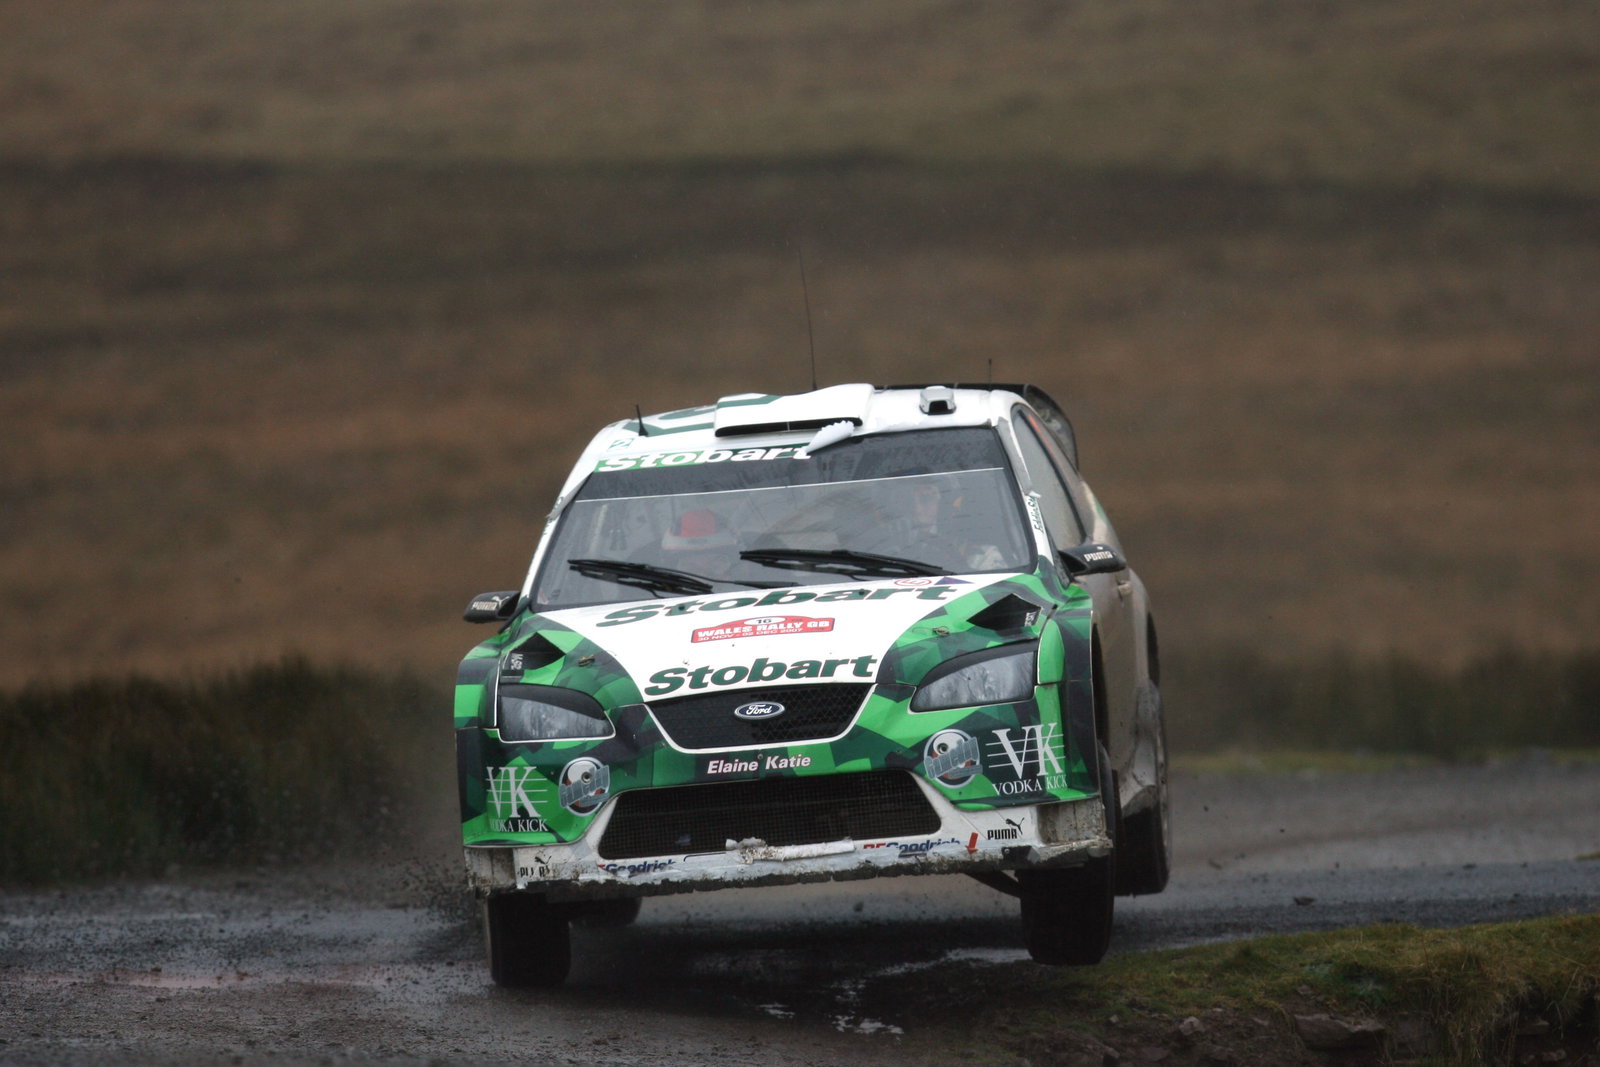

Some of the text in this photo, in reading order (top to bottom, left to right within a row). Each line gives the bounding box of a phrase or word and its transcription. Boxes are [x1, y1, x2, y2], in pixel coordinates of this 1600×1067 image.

[599, 445, 812, 472] Stobart
[1084, 551, 1113, 562] PUMA
[596, 586, 957, 627] Stobart
[697, 625, 753, 637] WALES
[756, 621, 803, 631] RALLY
[644, 655, 877, 696] Stobart
[745, 704, 773, 715] Ford
[992, 722, 1063, 780] VK
[707, 754, 811, 774] Elaine Katie
[486, 766, 541, 818] VK
[992, 774, 1068, 796] VODKA KICK
[518, 818, 549, 832] KICK
[987, 828, 1017, 840] PUMA
